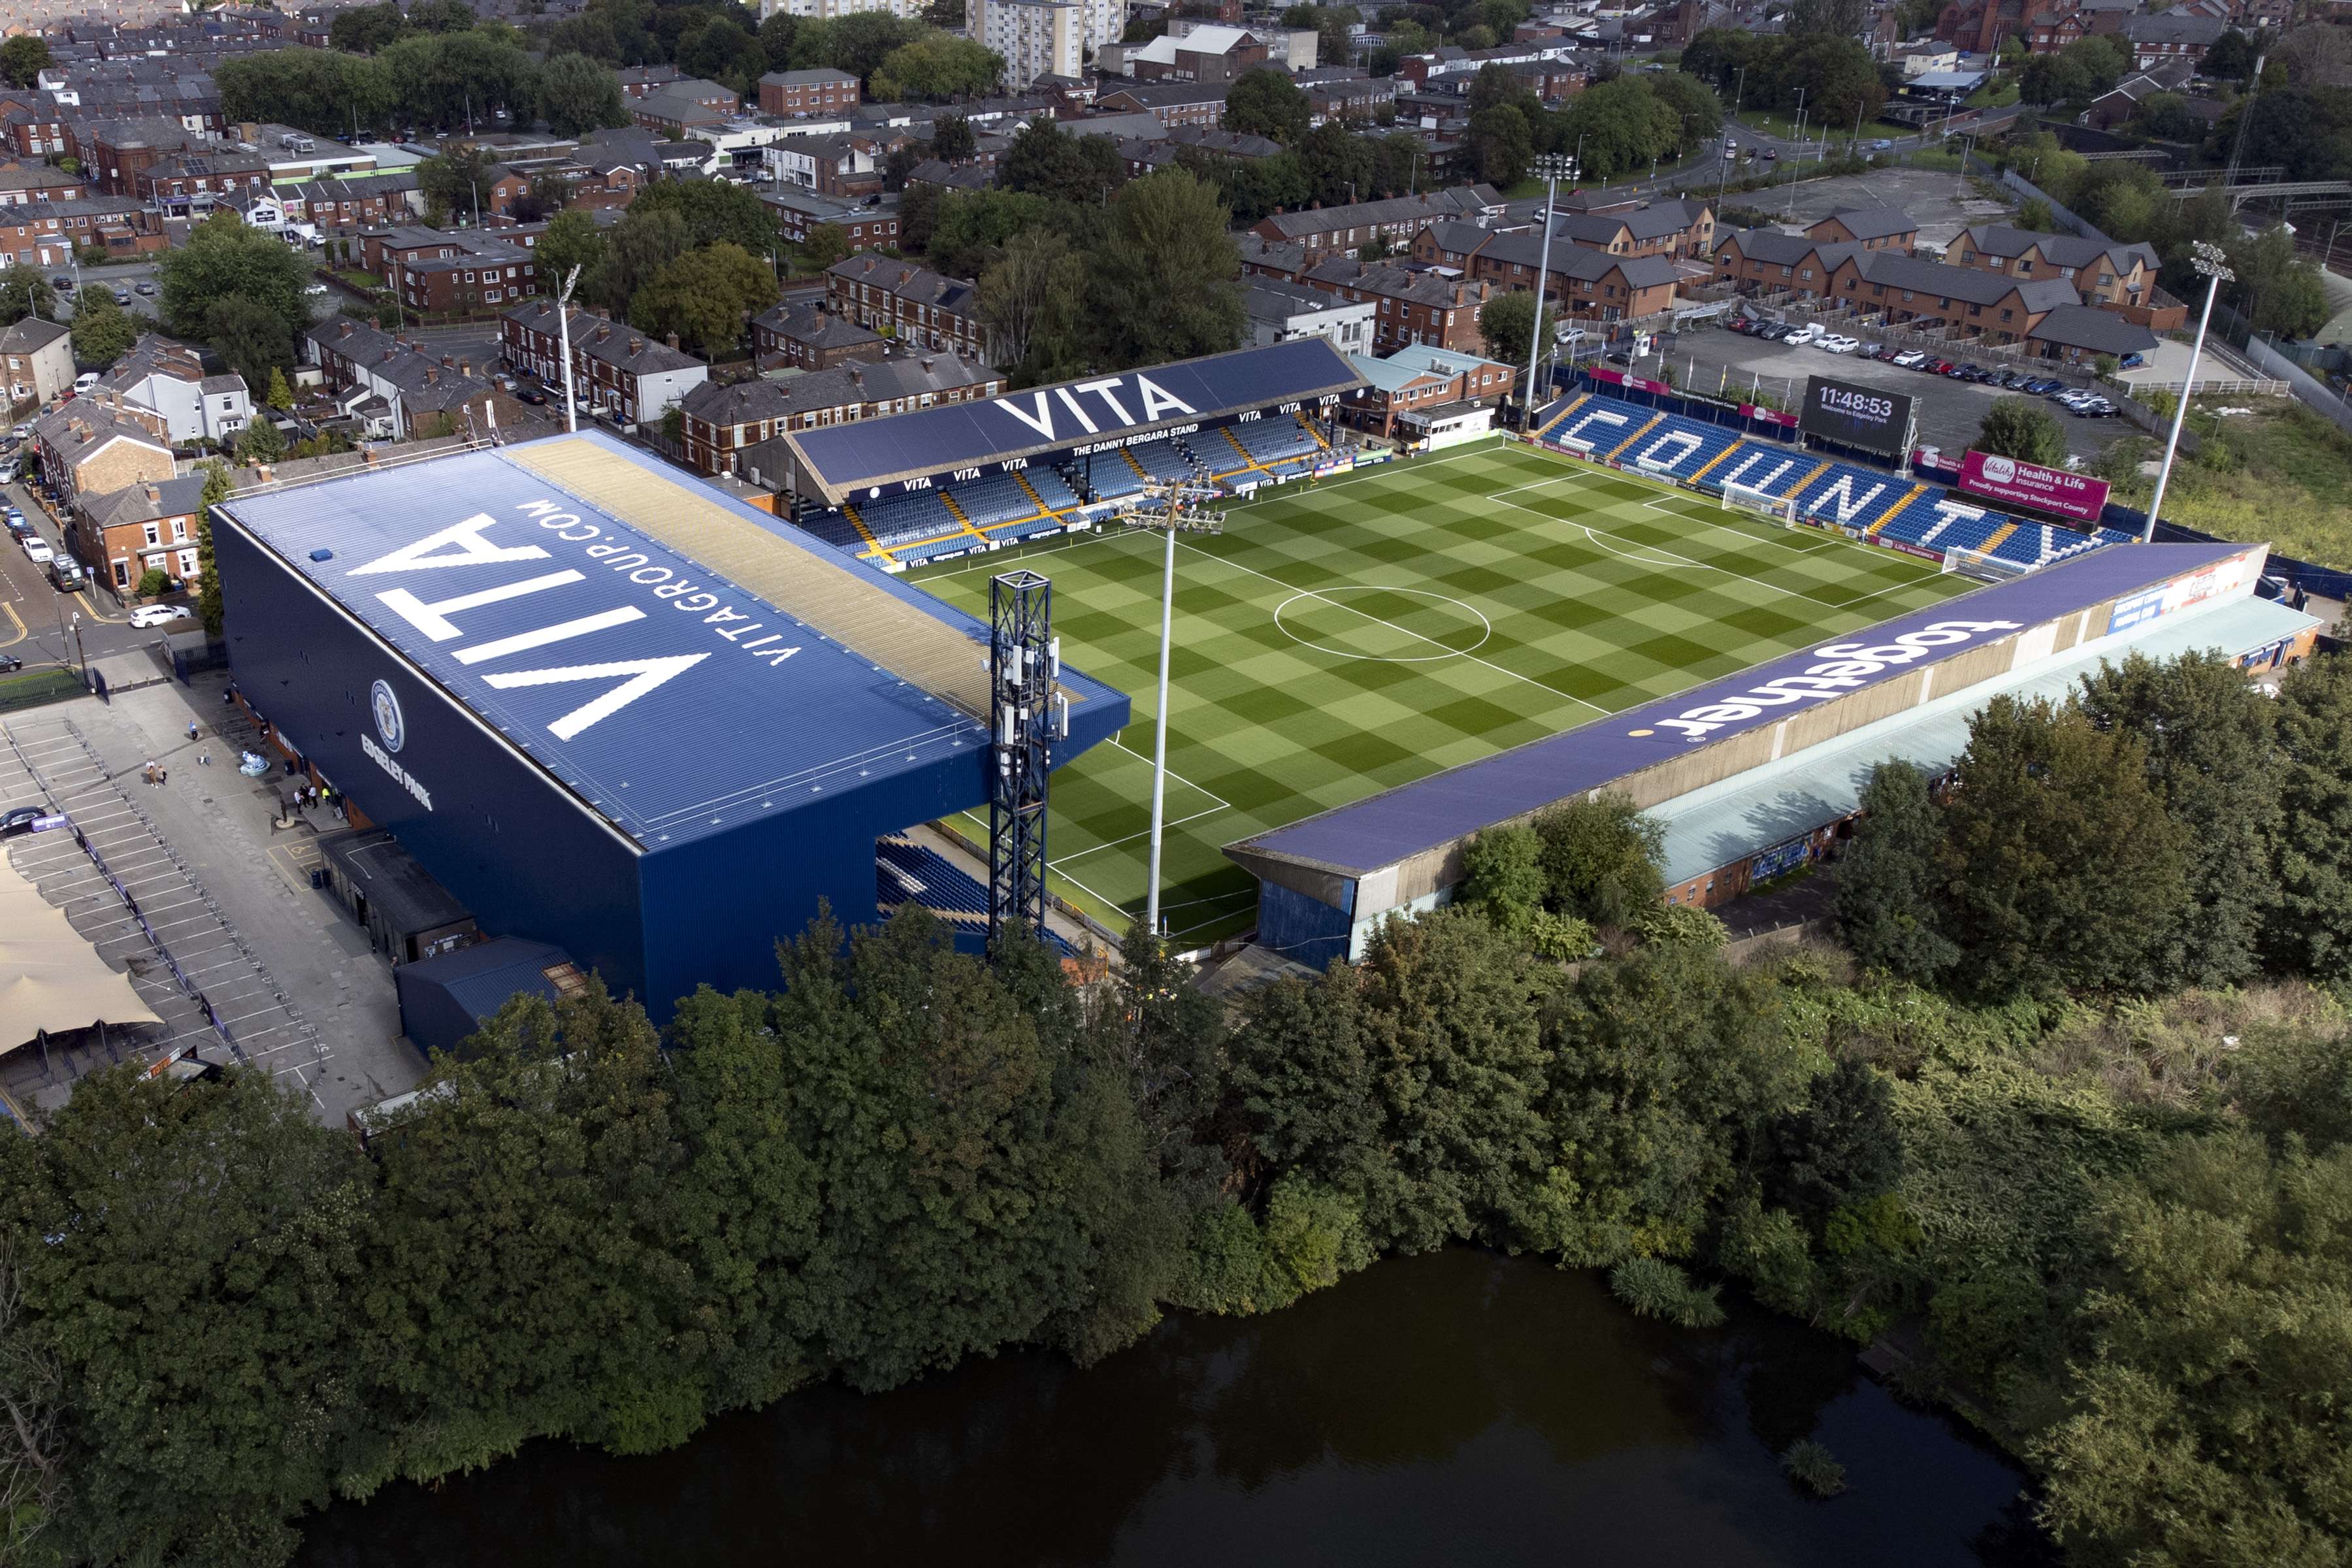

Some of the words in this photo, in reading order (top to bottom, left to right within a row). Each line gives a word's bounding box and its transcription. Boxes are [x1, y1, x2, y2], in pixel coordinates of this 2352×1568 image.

[1319, 393, 1340, 406] VITA
[1820, 386, 1892, 417] 11:48:53
[992, 373, 1198, 442] VITA
[1279, 402, 1301, 415] VITA
[1821, 403, 1846, 414] Welcome
[1852, 411, 1874, 421] Edgeley
[1239, 410, 1261, 423] VITA
[1073, 446, 1092, 457] THE
[1093, 438, 1124, 453] DANNY
[1126, 430, 1168, 446] BERGARA
[1170, 424, 1198, 437] STAND
[1002, 458, 1028, 472] VITA
[1939, 459, 1956, 468] Health
[1984, 459, 2014, 479] Vitality
[953, 468, 981, 482] VITA
[2017, 466, 2053, 483] Health
[2054, 474, 2062, 484] &
[2064, 477, 2085, 490] Life
[904, 477, 932, 491] VITA
[1259, 479, 1274, 487] VITA
[2016, 477, 2055, 492] insurance
[1559, 409, 2104, 574] COUNTY
[1968, 479, 1993, 492] Proudly
[1994, 485, 2029, 500] supporting
[2029, 493, 2062, 508] Stockport
[2063, 502, 2089, 515] County
[1001, 537, 1019, 547] VITA
[1029, 529, 1061, 540] vitagroup.com
[969, 545, 987, 555] VITA
[1895, 543, 1906, 551] Life
[1906, 547, 1934, 559] insurance
[910, 558, 928, 568] VITA
[515, 498, 802, 666] VITAGROUP.COM
[346, 512, 713, 742] VITA
[1654, 620, 2025, 736] together
[361, 733, 404, 785] EDGELEY
[404, 772, 433, 812] PARK
